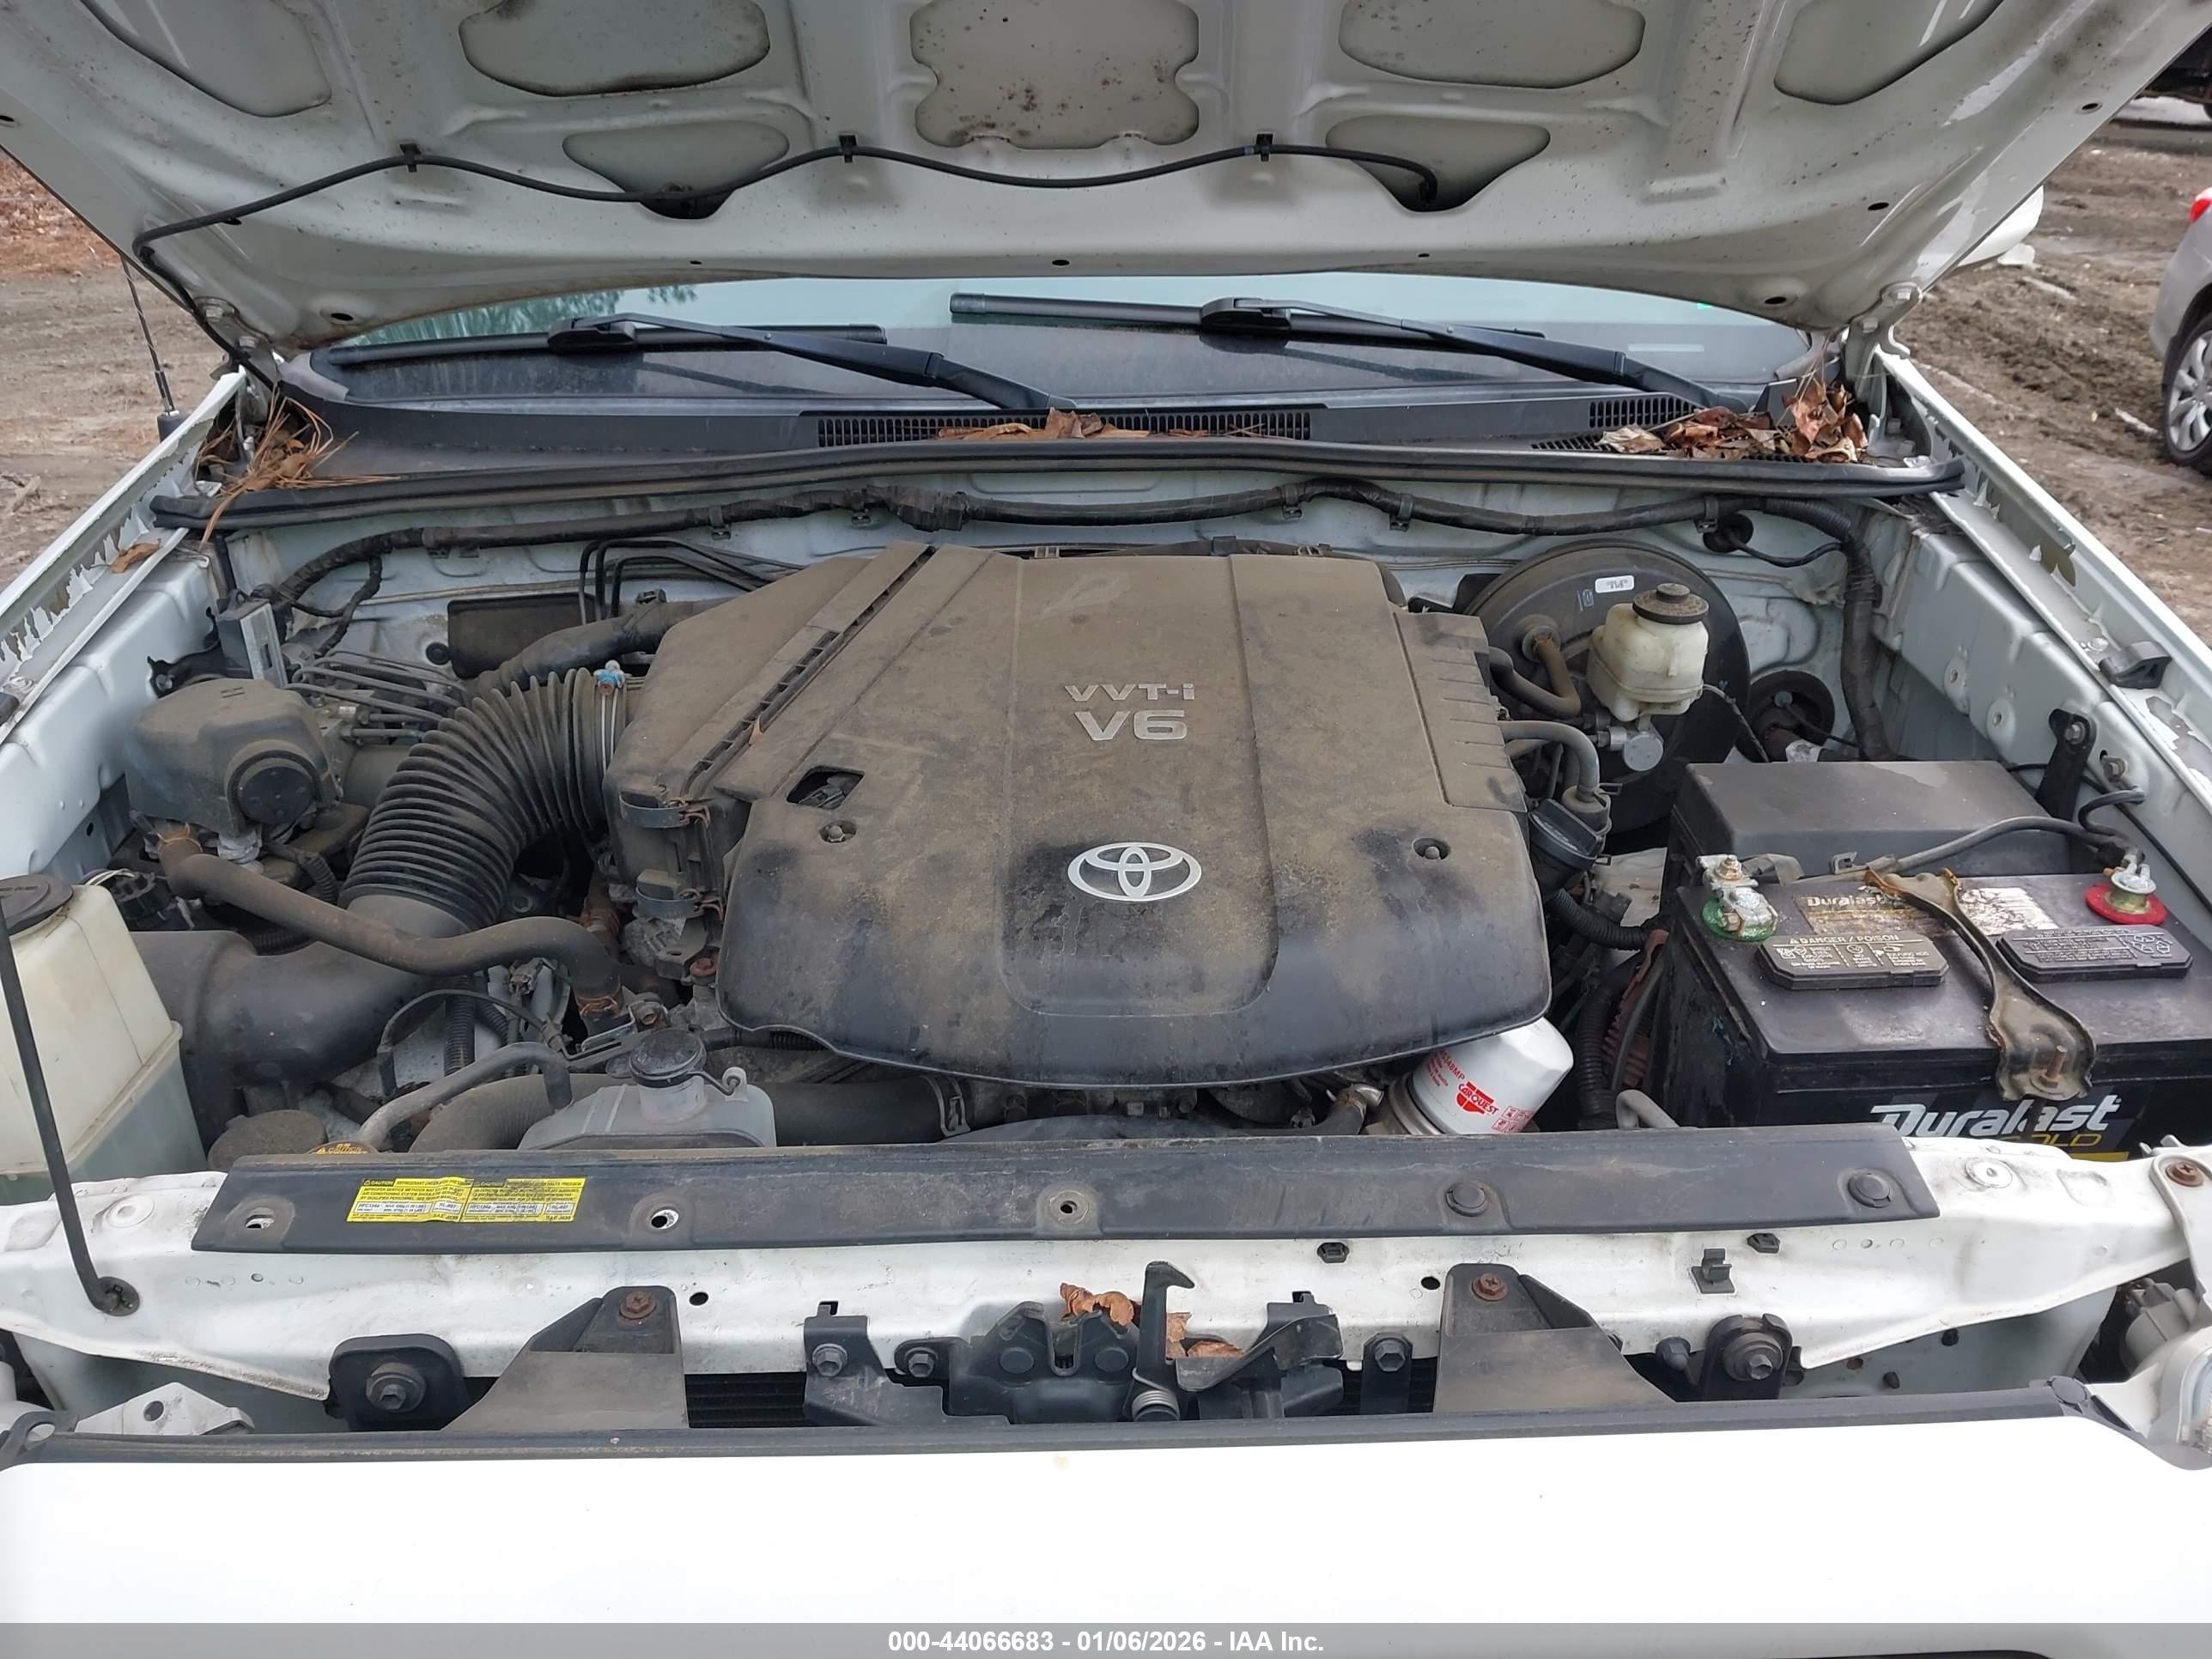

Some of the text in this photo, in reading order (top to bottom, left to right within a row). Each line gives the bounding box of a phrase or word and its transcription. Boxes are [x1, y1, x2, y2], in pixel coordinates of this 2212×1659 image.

[1064, 683, 1195, 702] VVT-i
[1074, 709, 1188, 741] V6
[1807, 895, 1883, 908] Duralast
[1458, 1083, 1498, 1115] CARQUEST
